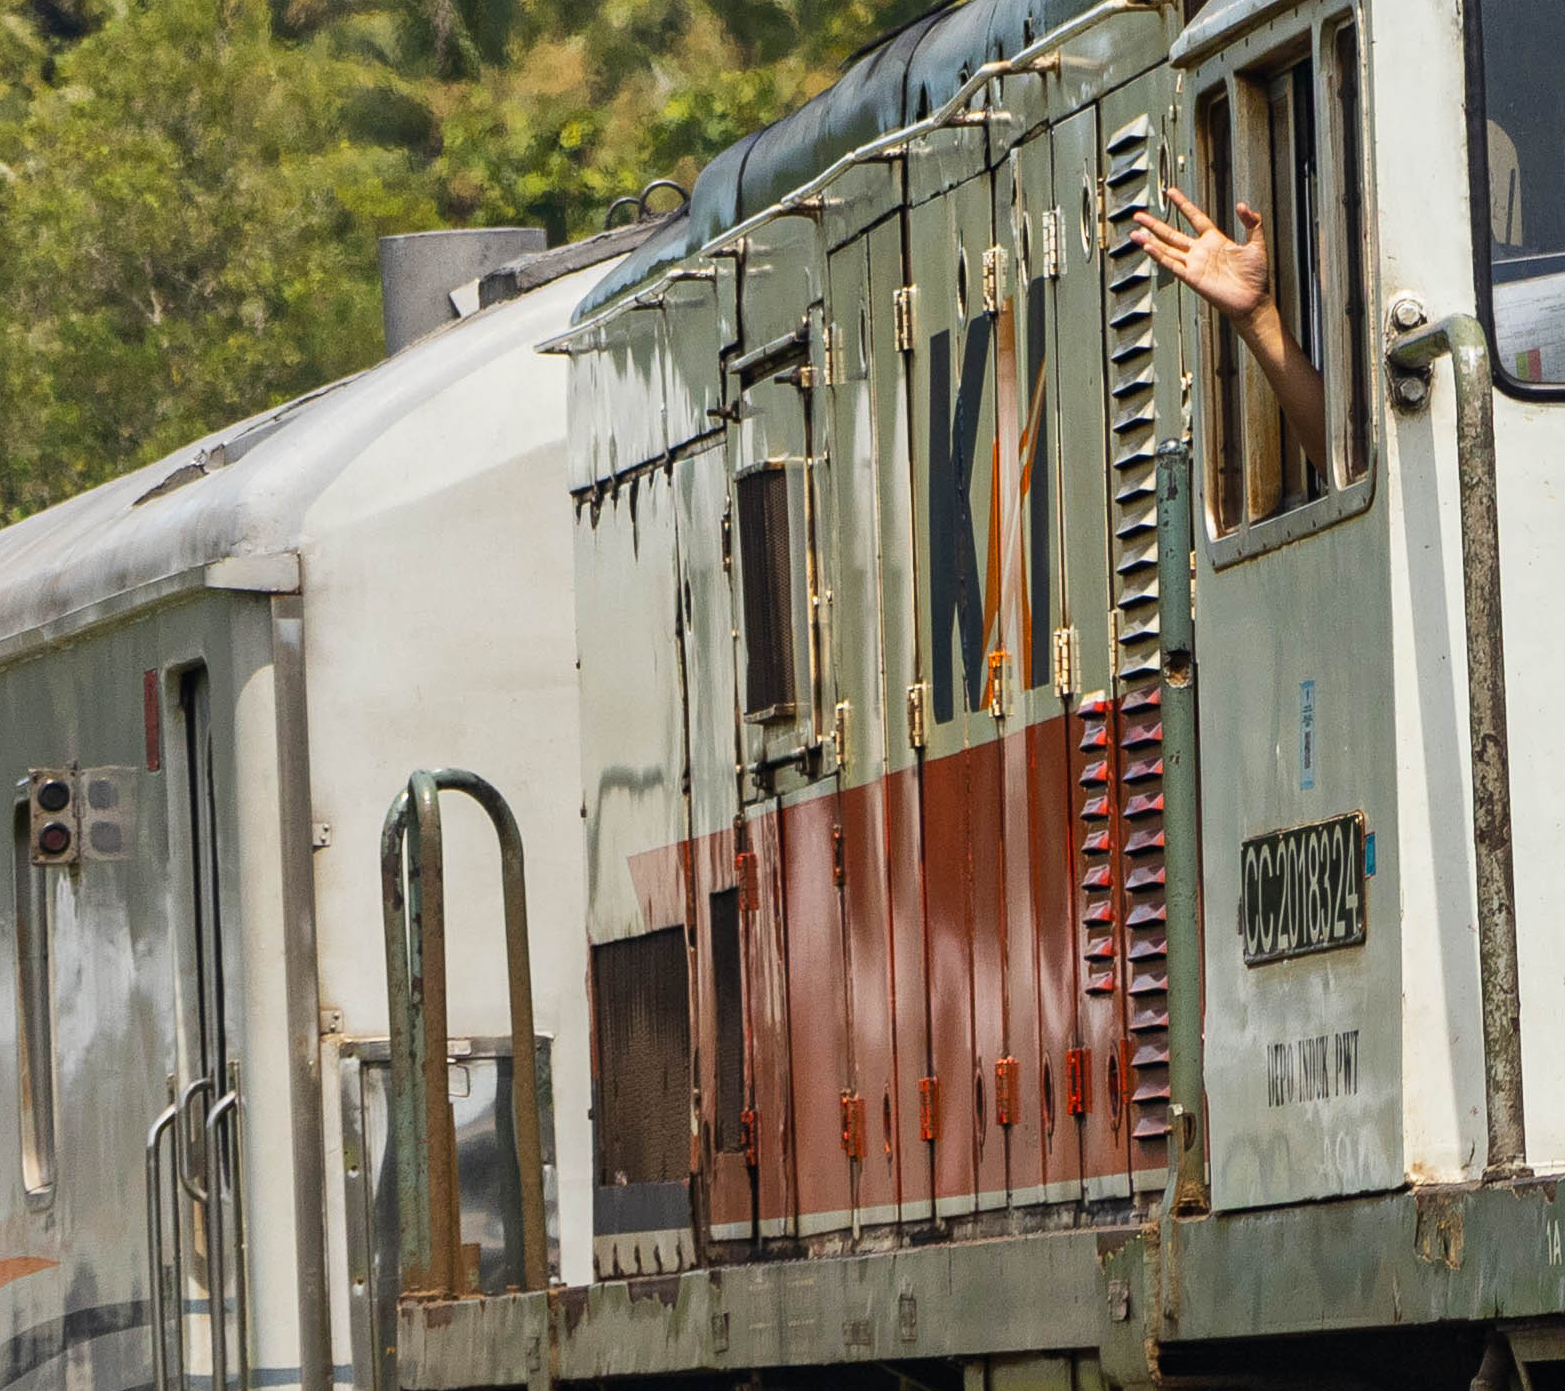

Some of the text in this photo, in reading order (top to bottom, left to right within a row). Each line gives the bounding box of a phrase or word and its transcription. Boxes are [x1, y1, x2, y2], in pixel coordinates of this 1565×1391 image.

[929, 276, 1051, 725] KAI
[1267, 1029, 1360, 1107] DEPO INDUK PWT
[1546, 1218, 1563, 1266] 1A
